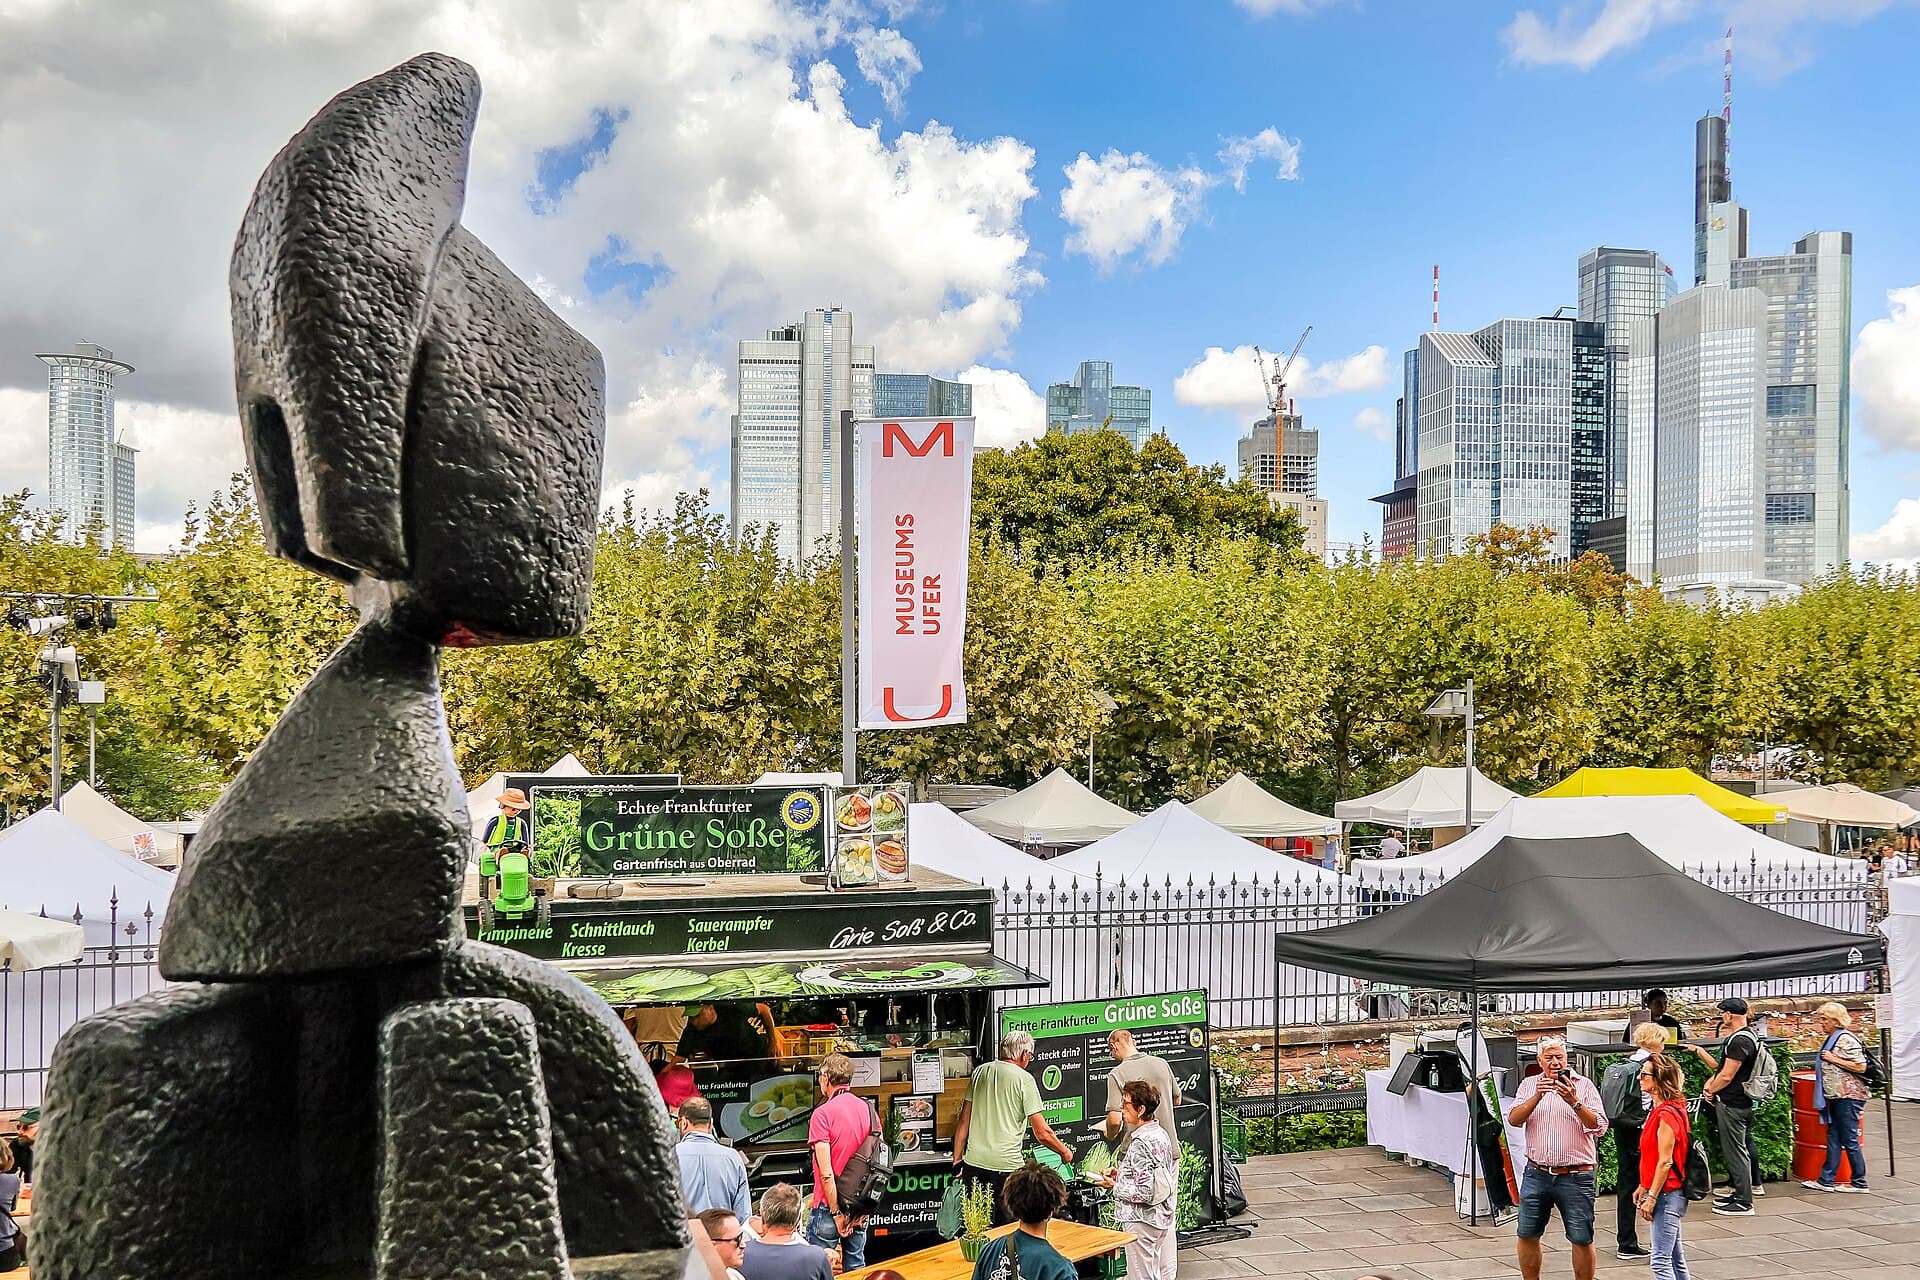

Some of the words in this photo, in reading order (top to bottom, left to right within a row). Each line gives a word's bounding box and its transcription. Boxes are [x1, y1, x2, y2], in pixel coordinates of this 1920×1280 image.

[895, 513, 915, 635] MUSEUMS
[922, 574, 941, 635] UFER
[617, 800, 660, 815] Echte
[663, 799, 752, 814] Frankfurter
[586, 820, 696, 851] Grüne
[706, 817, 786, 850] Soße
[613, 857, 687, 871] Gartenfrisch
[689, 860, 706, 868] aus
[707, 856, 756, 868] Oberrad
[569, 921, 655, 938] Schnittlauch
[687, 916, 774, 935] Sauerampfer
[829, 926, 875, 948] Grie
[927, 911, 947, 933] &
[950, 909, 976, 930] Co.
[561, 942, 606, 957] Kresse
[686, 936, 730, 952] Kerbel
[1041, 1014, 1099, 1030] Frankfurter
[1104, 1001, 1157, 1023] Grüne
[1161, 996, 1202, 1018] Soße
[1037, 1049, 1061, 1061] steckt
[1061, 1047, 1081, 1058] drin?
[710, 1081, 749, 1090] Frankfurter
[1047, 1070, 1057, 1087] 7
[1063, 1100, 1076, 1108] aus
[892, 1201, 927, 1211] Gärtnerei
[867, 1210, 938, 1226] dhelden-fra
